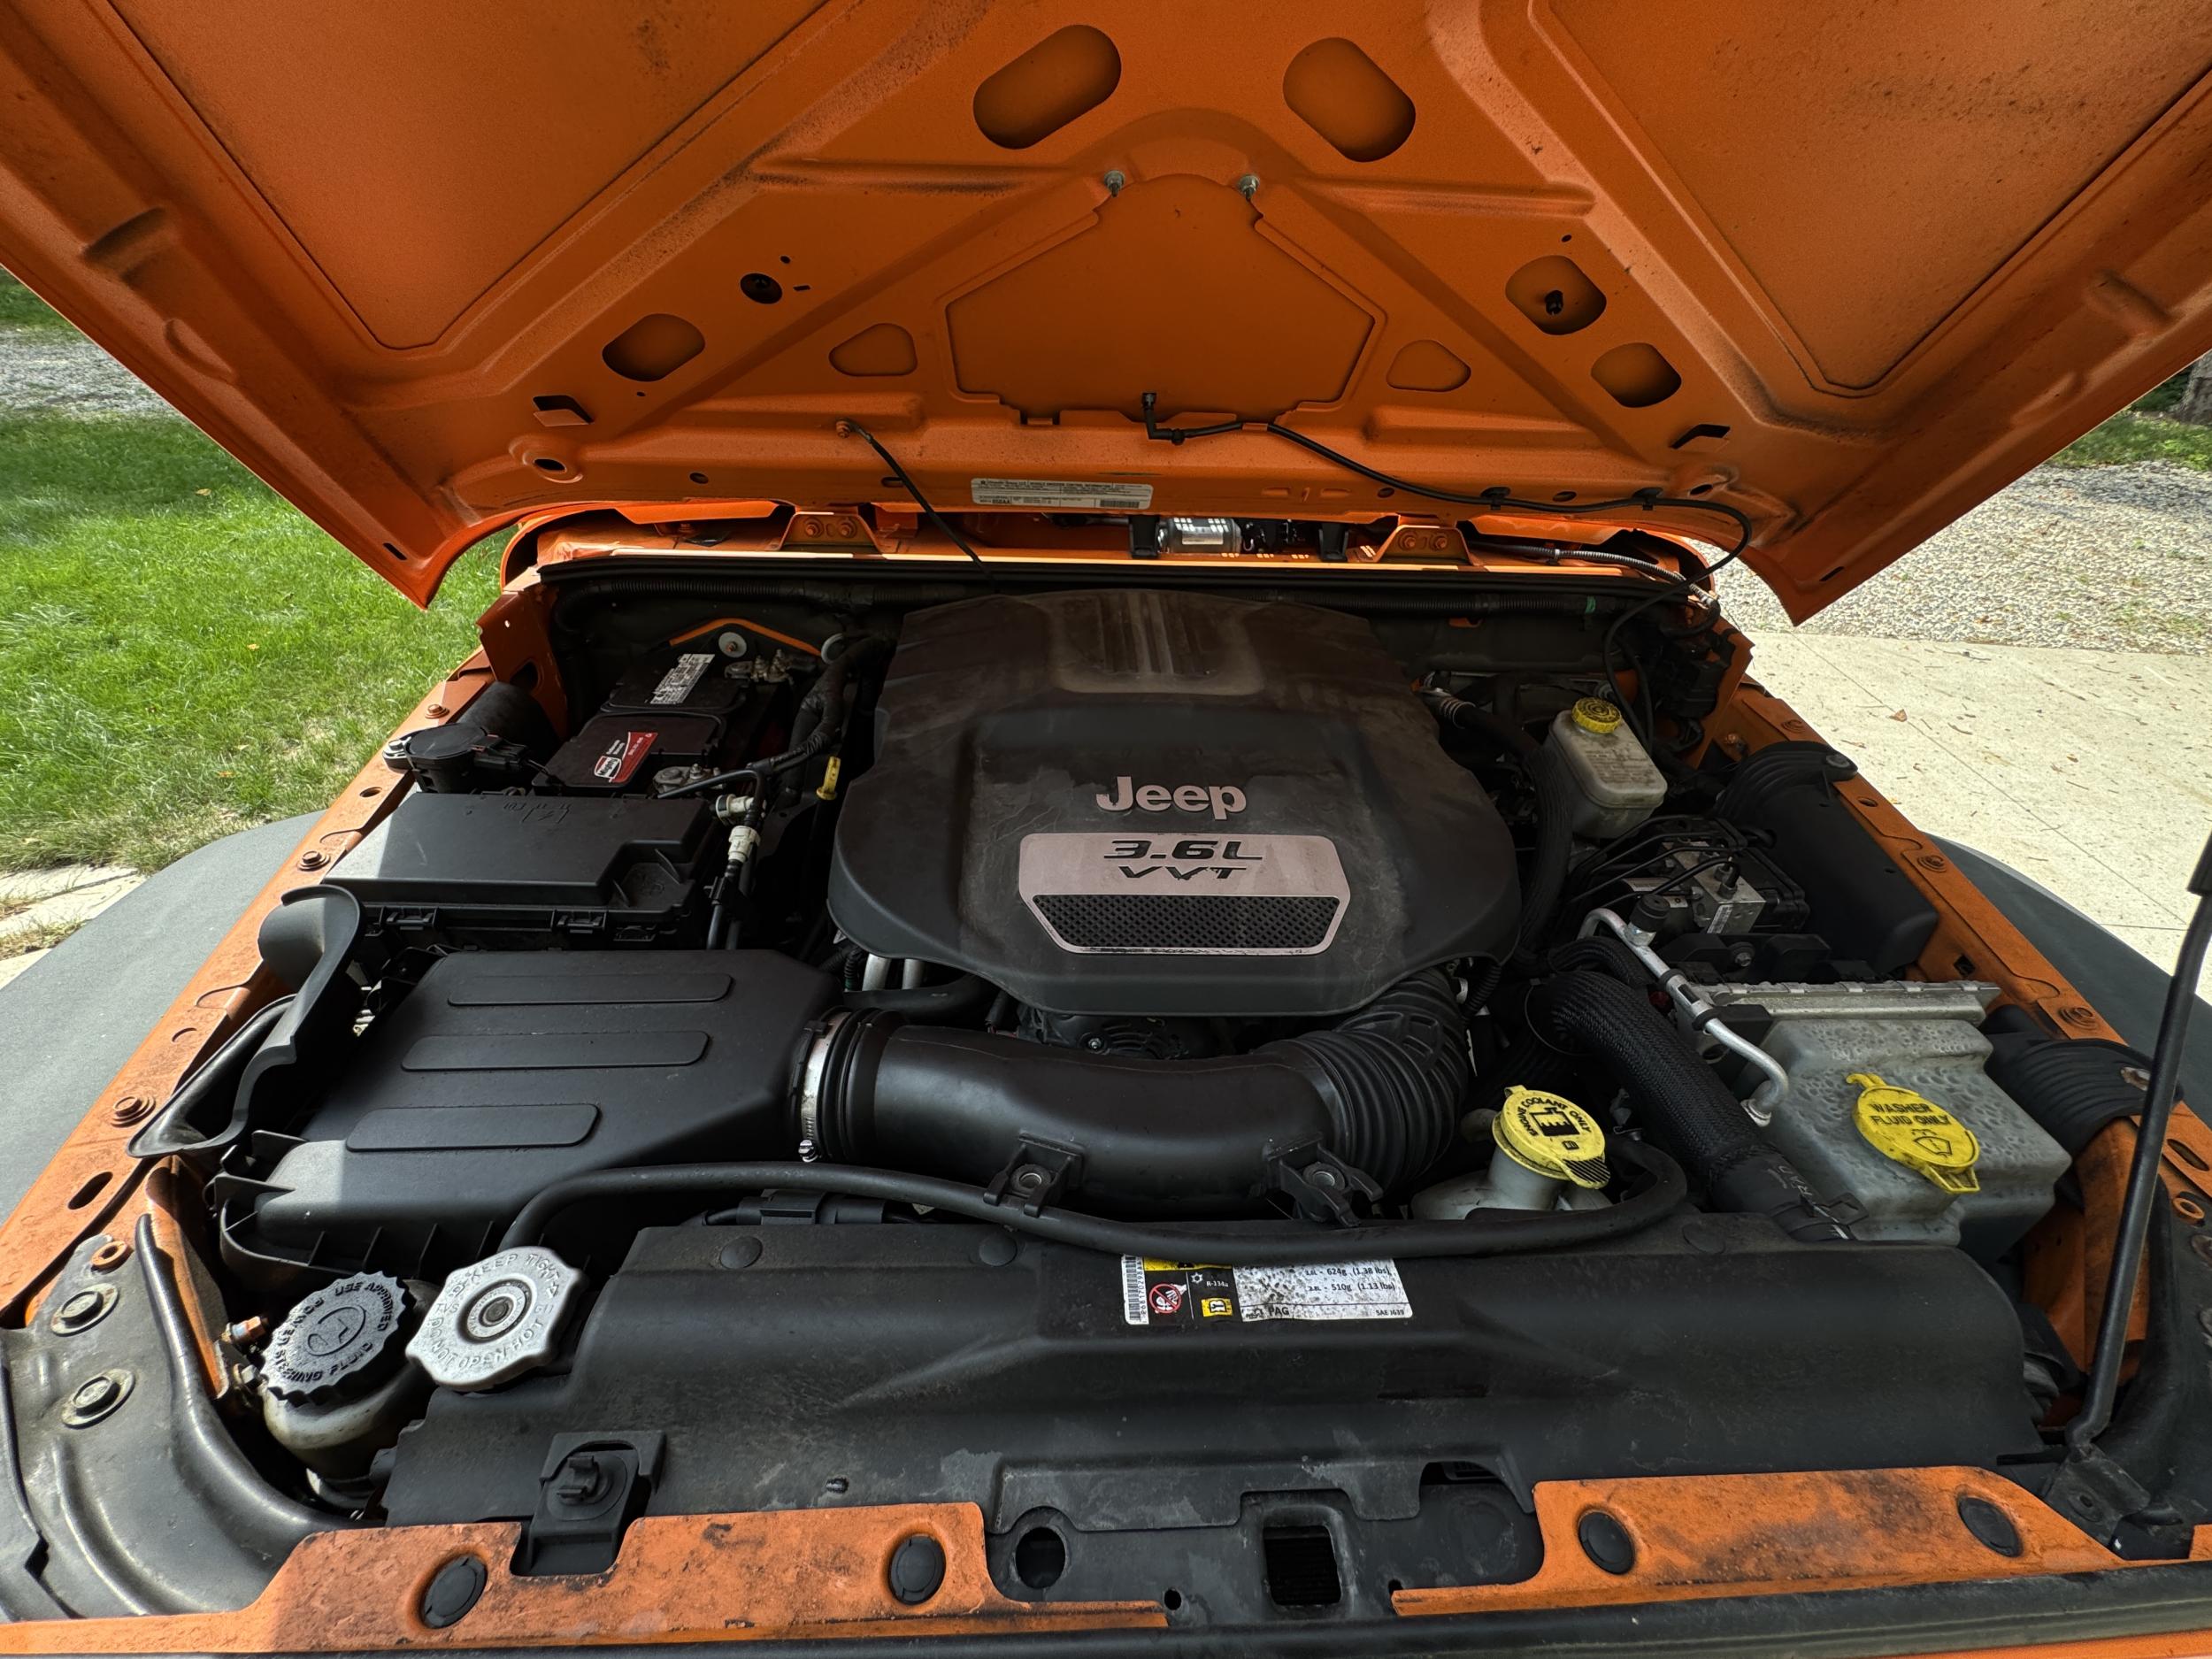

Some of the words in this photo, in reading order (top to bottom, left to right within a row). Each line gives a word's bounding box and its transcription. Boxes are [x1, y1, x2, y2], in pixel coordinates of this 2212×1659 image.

[1095, 776, 1247, 820] Jeep
[1103, 840, 1263, 860] 3.6L
[1118, 866, 1247, 880] VVT
[1521, 1096, 1568, 1110] COOLANT
[1868, 1102, 1934, 1113] WASHER
[1517, 1106, 1539, 1137] ENGINE
[1569, 1110, 1592, 1133] ONLY
[1869, 1115, 1912, 1125] FLUID
[1913, 1115, 1952, 1125] ONLY
[470, 1252, 518, 1282] KEEP
[526, 1253, 560, 1283] TIGHT
[1327, 1267, 1348, 1277] 624g
[1353, 1266, 1374, 1277] (1.38
[1374, 1265, 1390, 1276] lbs)
[334, 1282, 363, 1296] USE
[1331, 1283, 1352, 1293] 510g
[1357, 1282, 1379, 1292] (1.13
[1379, 1281, 1395, 1292] lbs)
[1268, 1306, 1290, 1317] PAG
[276, 1297, 325, 1346] POWER
[432, 1340, 458, 1371] NOT
[459, 1346, 507, 1369] OPEN
[513, 1318, 544, 1351] HOT
[329, 1342, 373, 1376] FLUID
